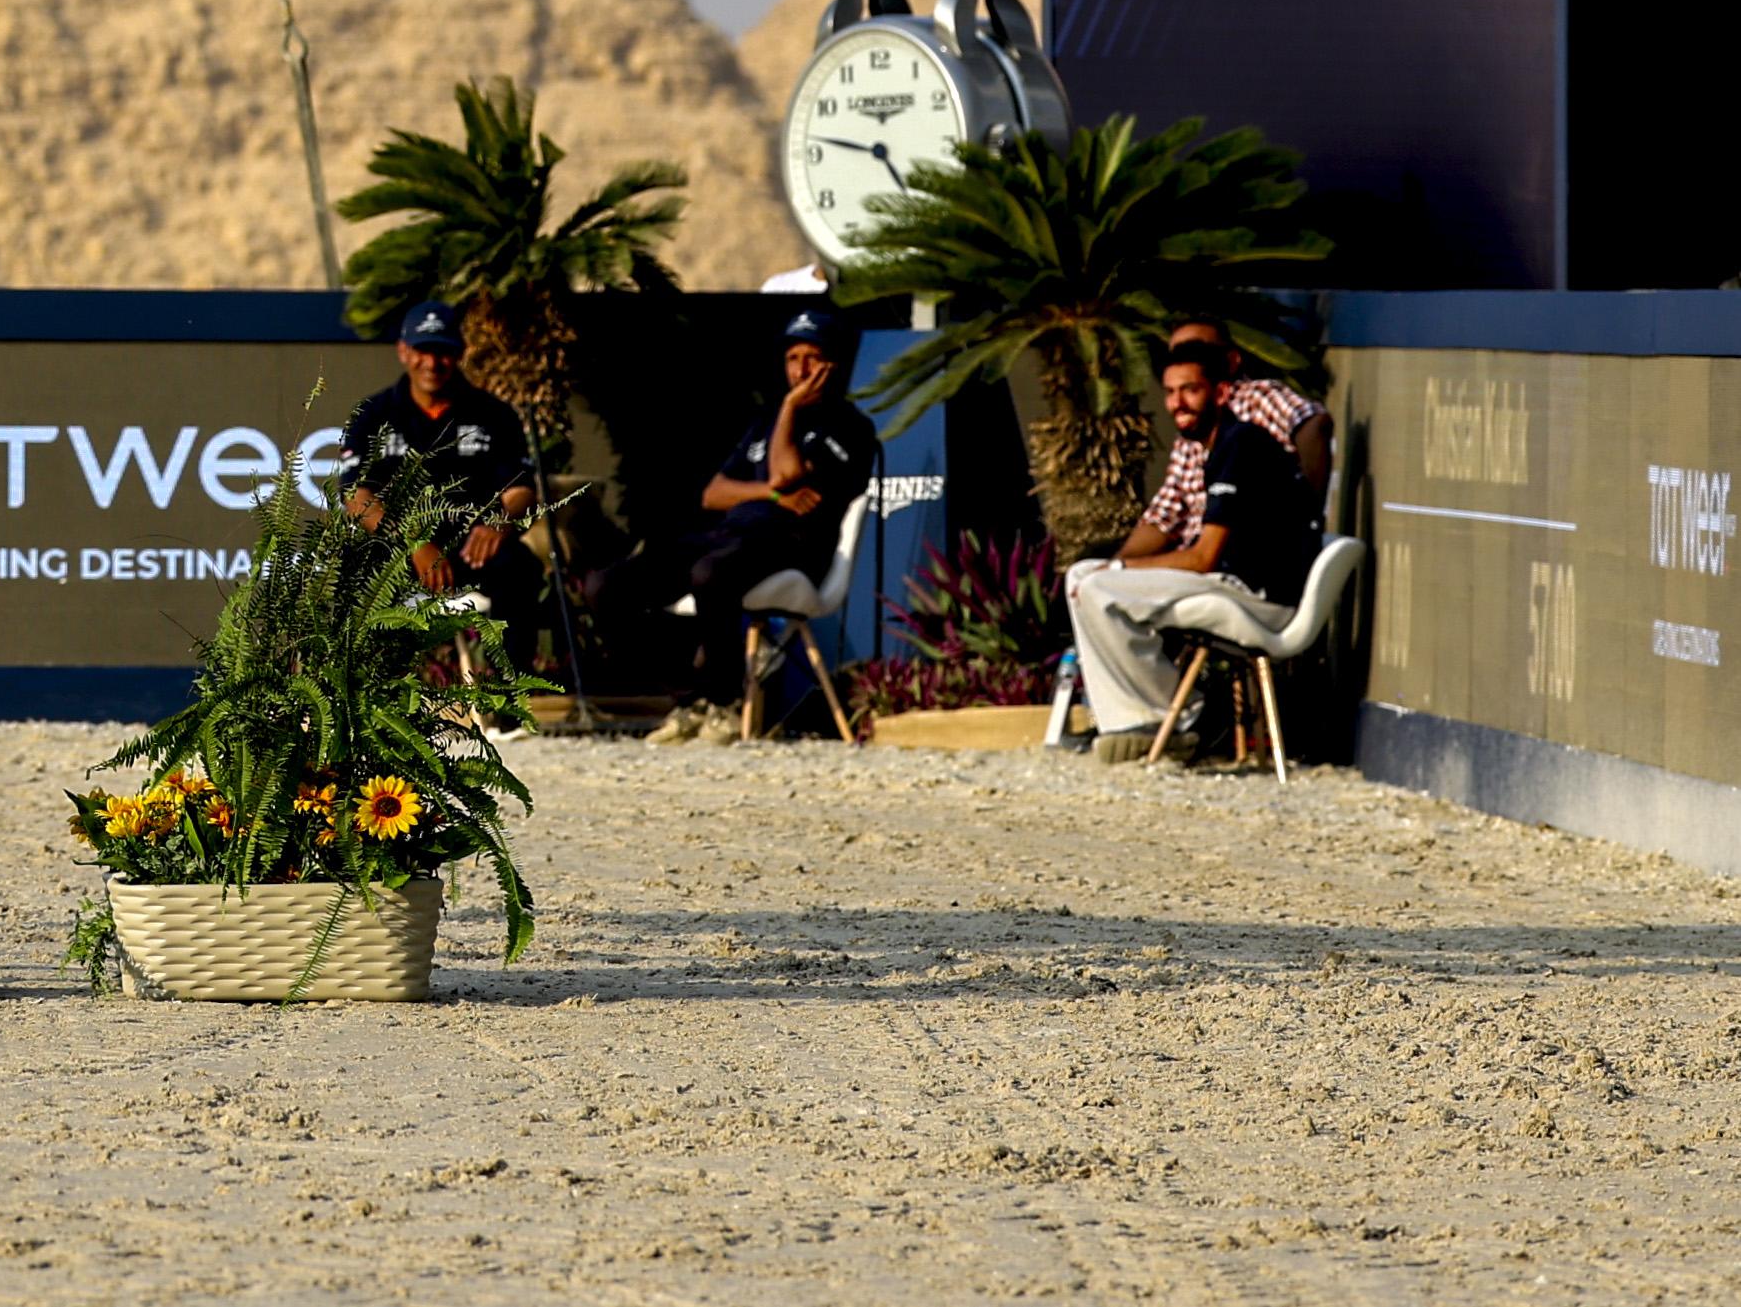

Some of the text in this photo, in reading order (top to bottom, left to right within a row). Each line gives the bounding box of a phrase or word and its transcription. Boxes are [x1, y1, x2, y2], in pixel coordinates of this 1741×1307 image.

[870, 49, 890, 70] 12
[839, 65, 854, 84] 11
[912, 61, 919, 80] 1
[818, 98, 837, 118] 10
[847, 92, 916, 111] LONGINES
[931, 91, 947, 110] 2
[819, 189, 835, 210] 8
[80, 547, 254, 581] DESTINA
